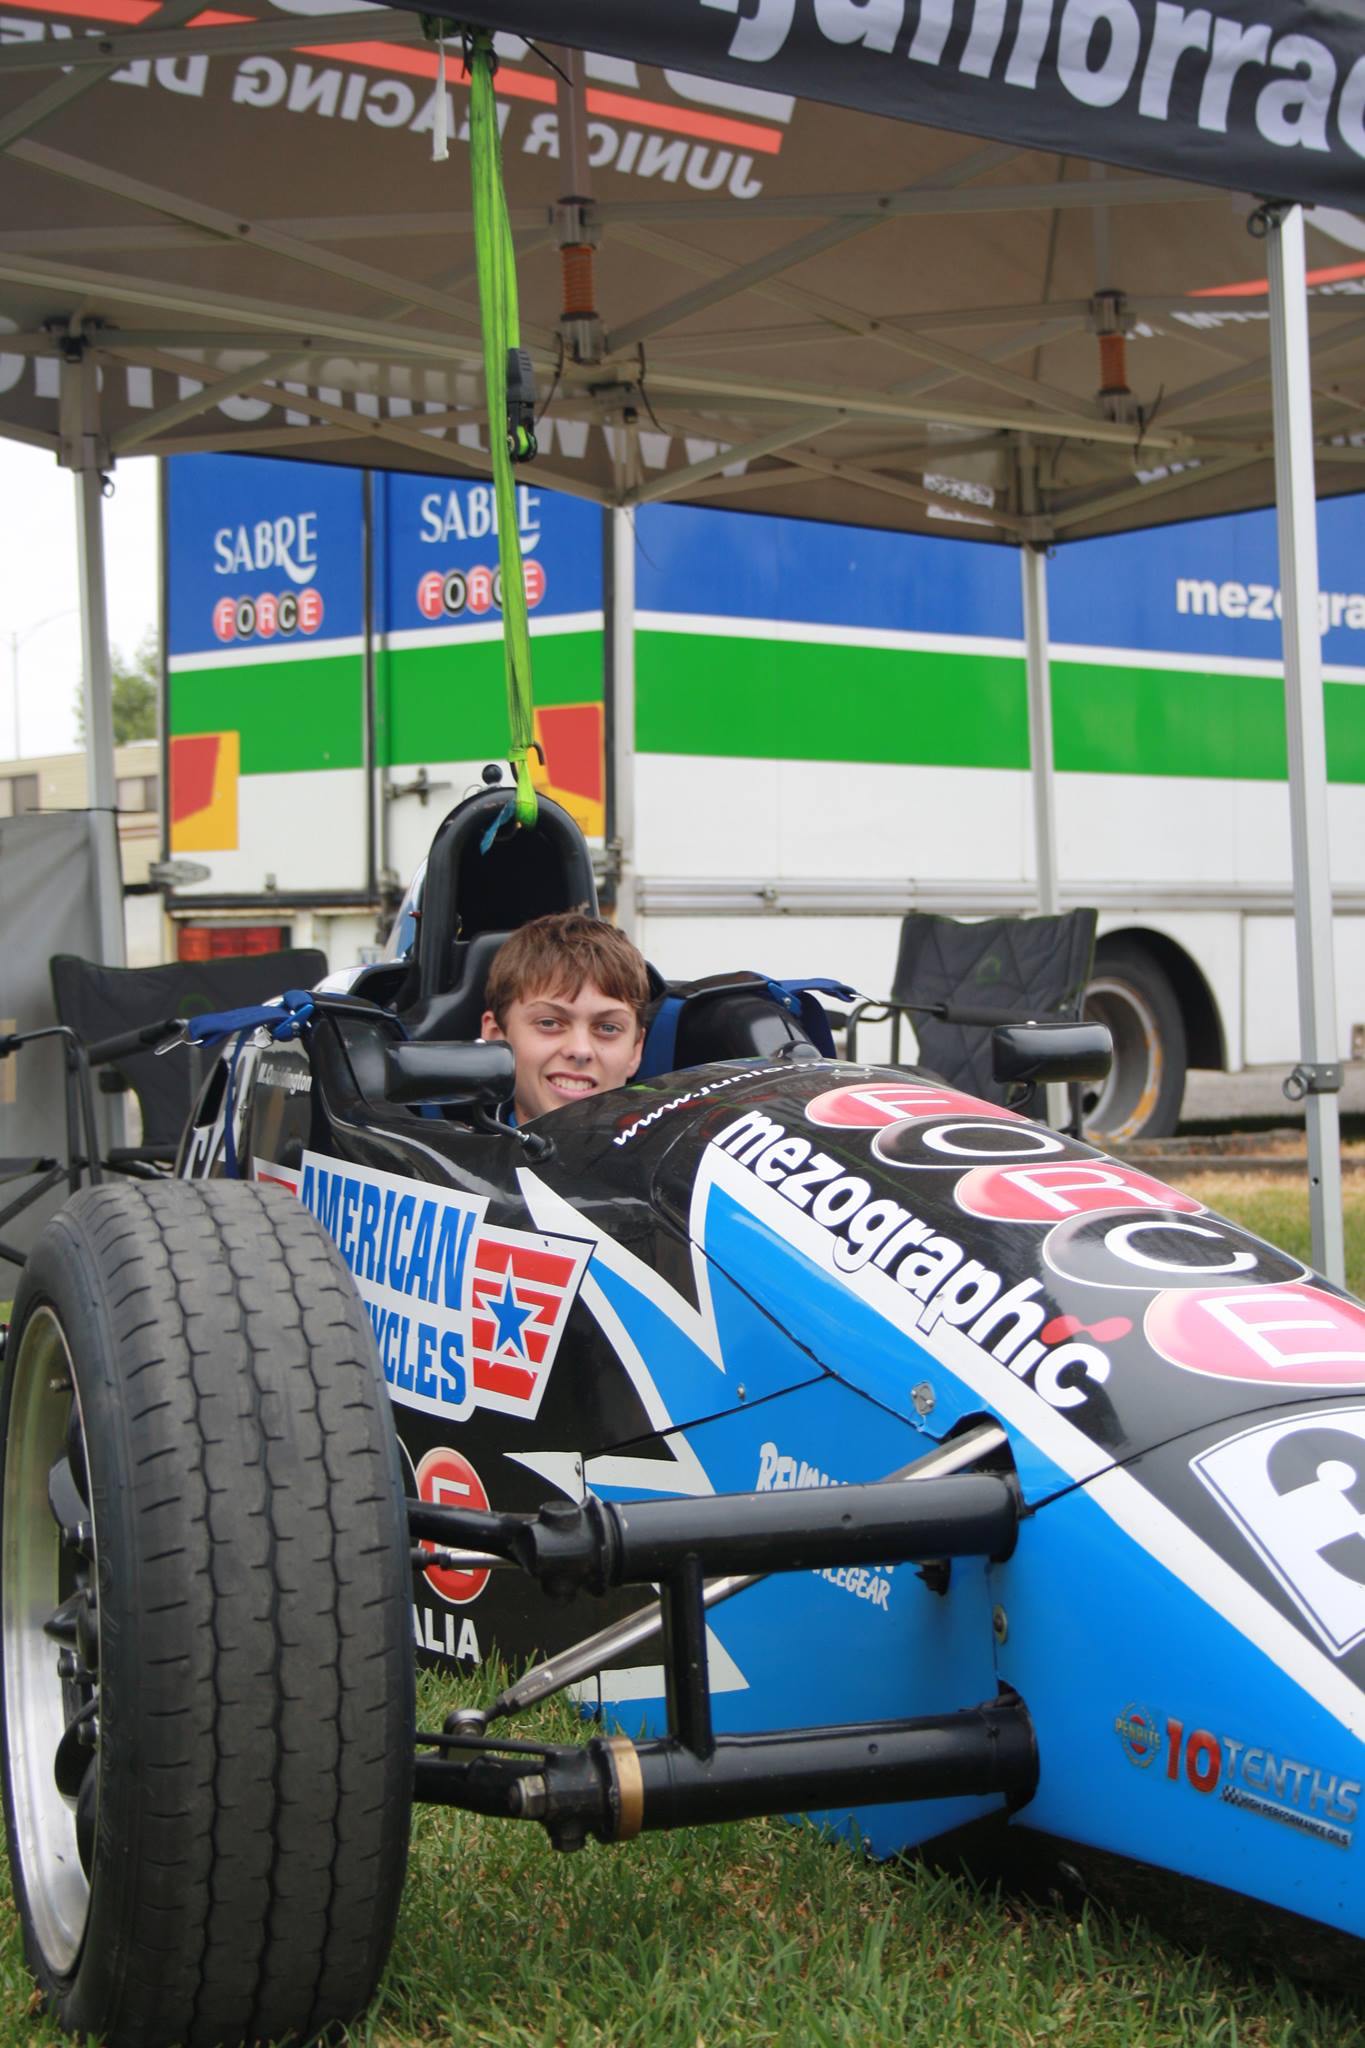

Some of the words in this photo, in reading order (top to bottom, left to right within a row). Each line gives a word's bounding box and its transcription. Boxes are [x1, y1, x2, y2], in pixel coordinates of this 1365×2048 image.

[213, 511, 318, 585] SABRE
[217, 596, 320, 636] FORCE
[711, 1109, 1112, 1409] mezographic
[1166, 1717, 1221, 1793] 10
[1223, 1736, 1361, 1824] TENTHS
